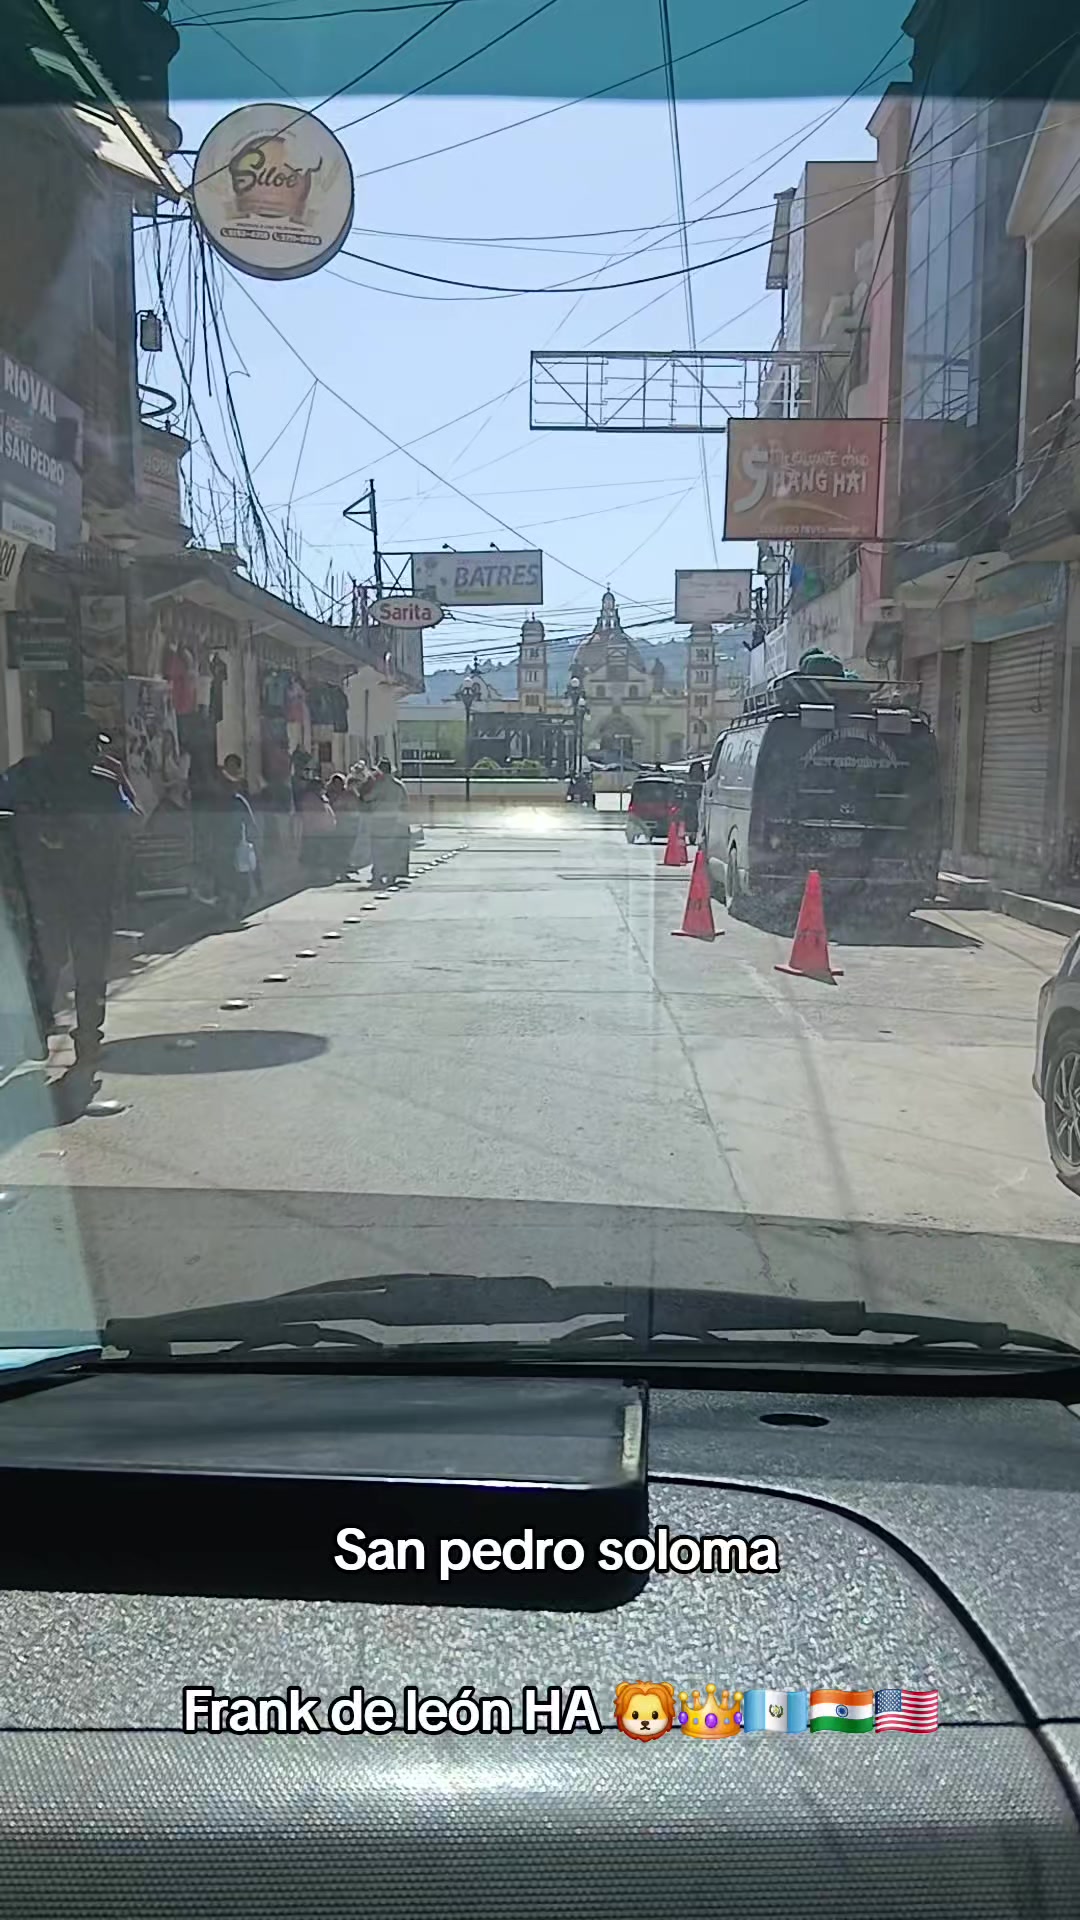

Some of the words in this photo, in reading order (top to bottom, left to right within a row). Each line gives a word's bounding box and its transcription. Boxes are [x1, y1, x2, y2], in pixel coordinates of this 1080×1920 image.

[4, 356, 57, 423] RIOVAL
[4, 430, 30, 468] SAN
[30, 447, 65, 487] PEDRO
[832, 469, 868, 498] HAI
[454, 564, 540, 588] BATRES
[379, 603, 432, 621] Sarita
